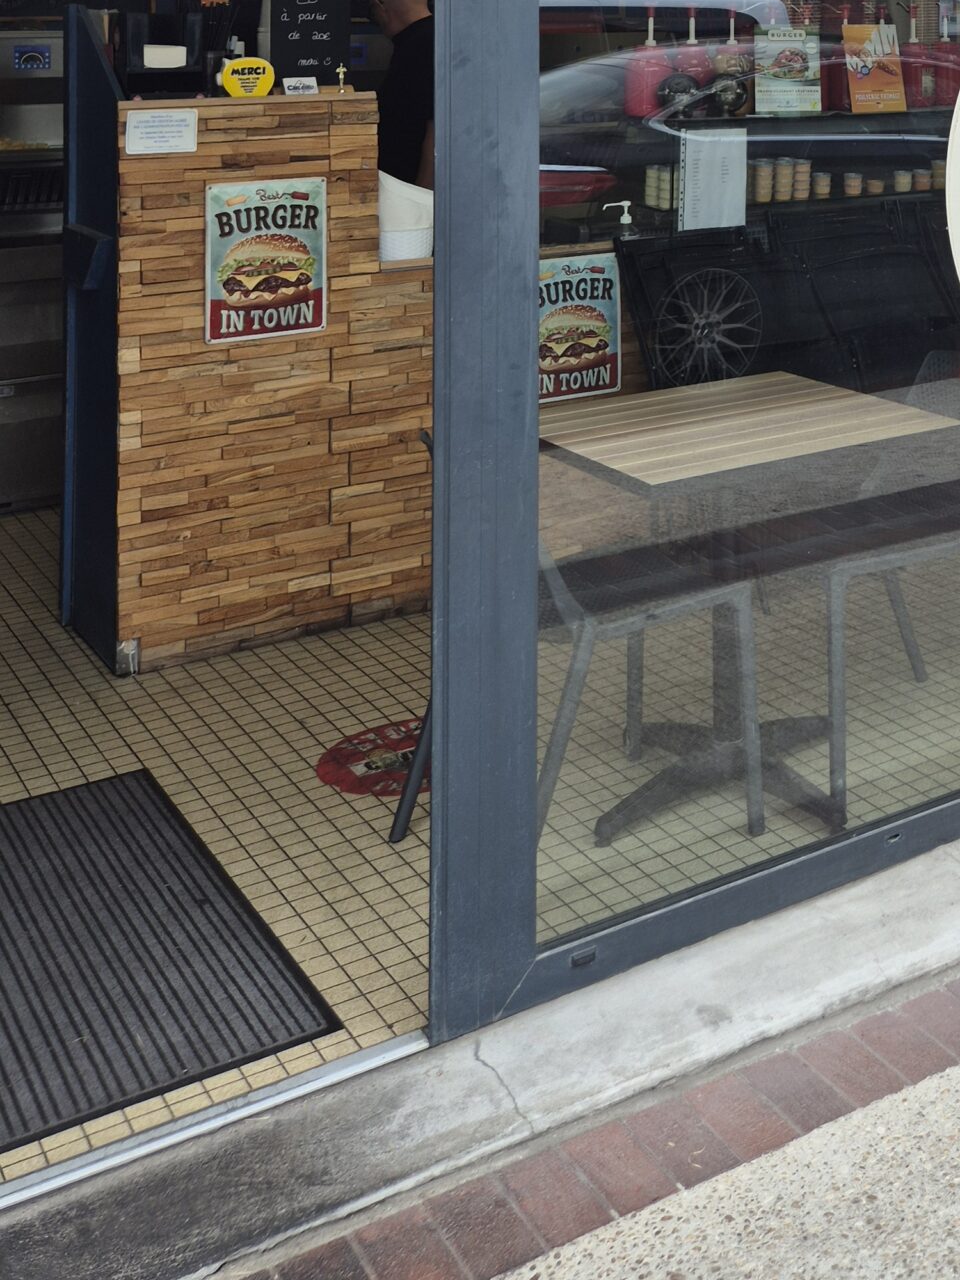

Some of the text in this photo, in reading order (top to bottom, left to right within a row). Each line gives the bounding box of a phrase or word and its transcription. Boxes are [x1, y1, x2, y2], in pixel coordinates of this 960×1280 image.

[280, 8, 291, 22] à
[288, 29, 302, 41] de
[230, 66, 267, 77] MERCI
[255, 188, 284, 202] Best
[214, 204, 319, 238] BURGER
[561, 264, 583, 276] Best
[220, 300, 315, 334] IN TOWN
[539, 364, 612, 395] N TOWN
